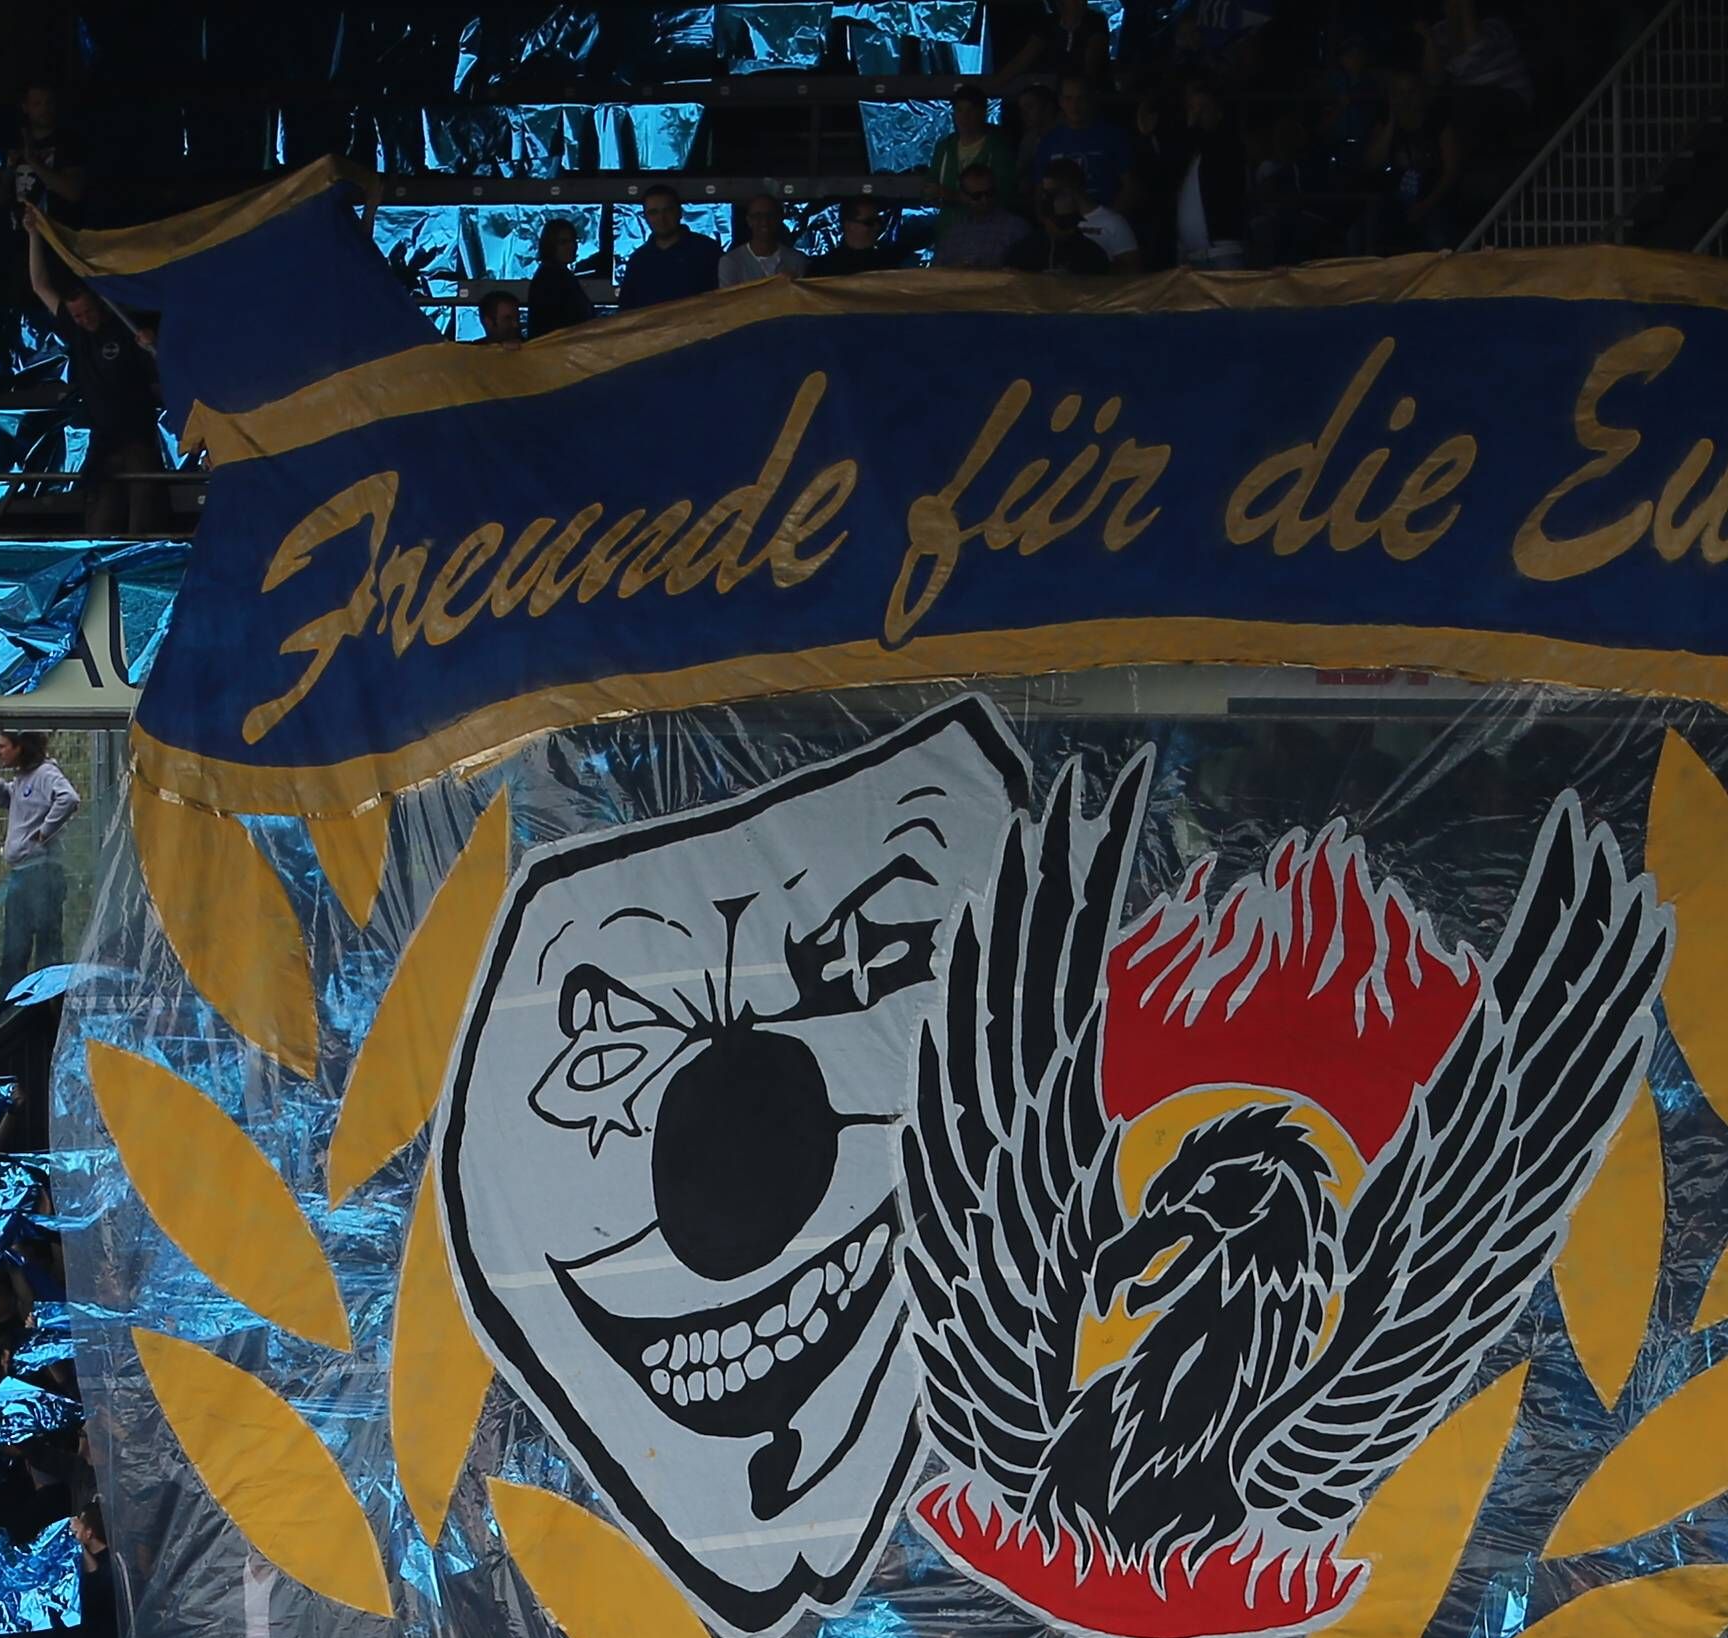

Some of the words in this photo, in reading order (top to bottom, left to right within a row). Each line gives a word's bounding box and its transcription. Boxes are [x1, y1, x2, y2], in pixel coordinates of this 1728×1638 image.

[242, 371, 859, 746] Freunde
[883, 379, 1173, 646] für
[1224, 336, 1478, 560] die
